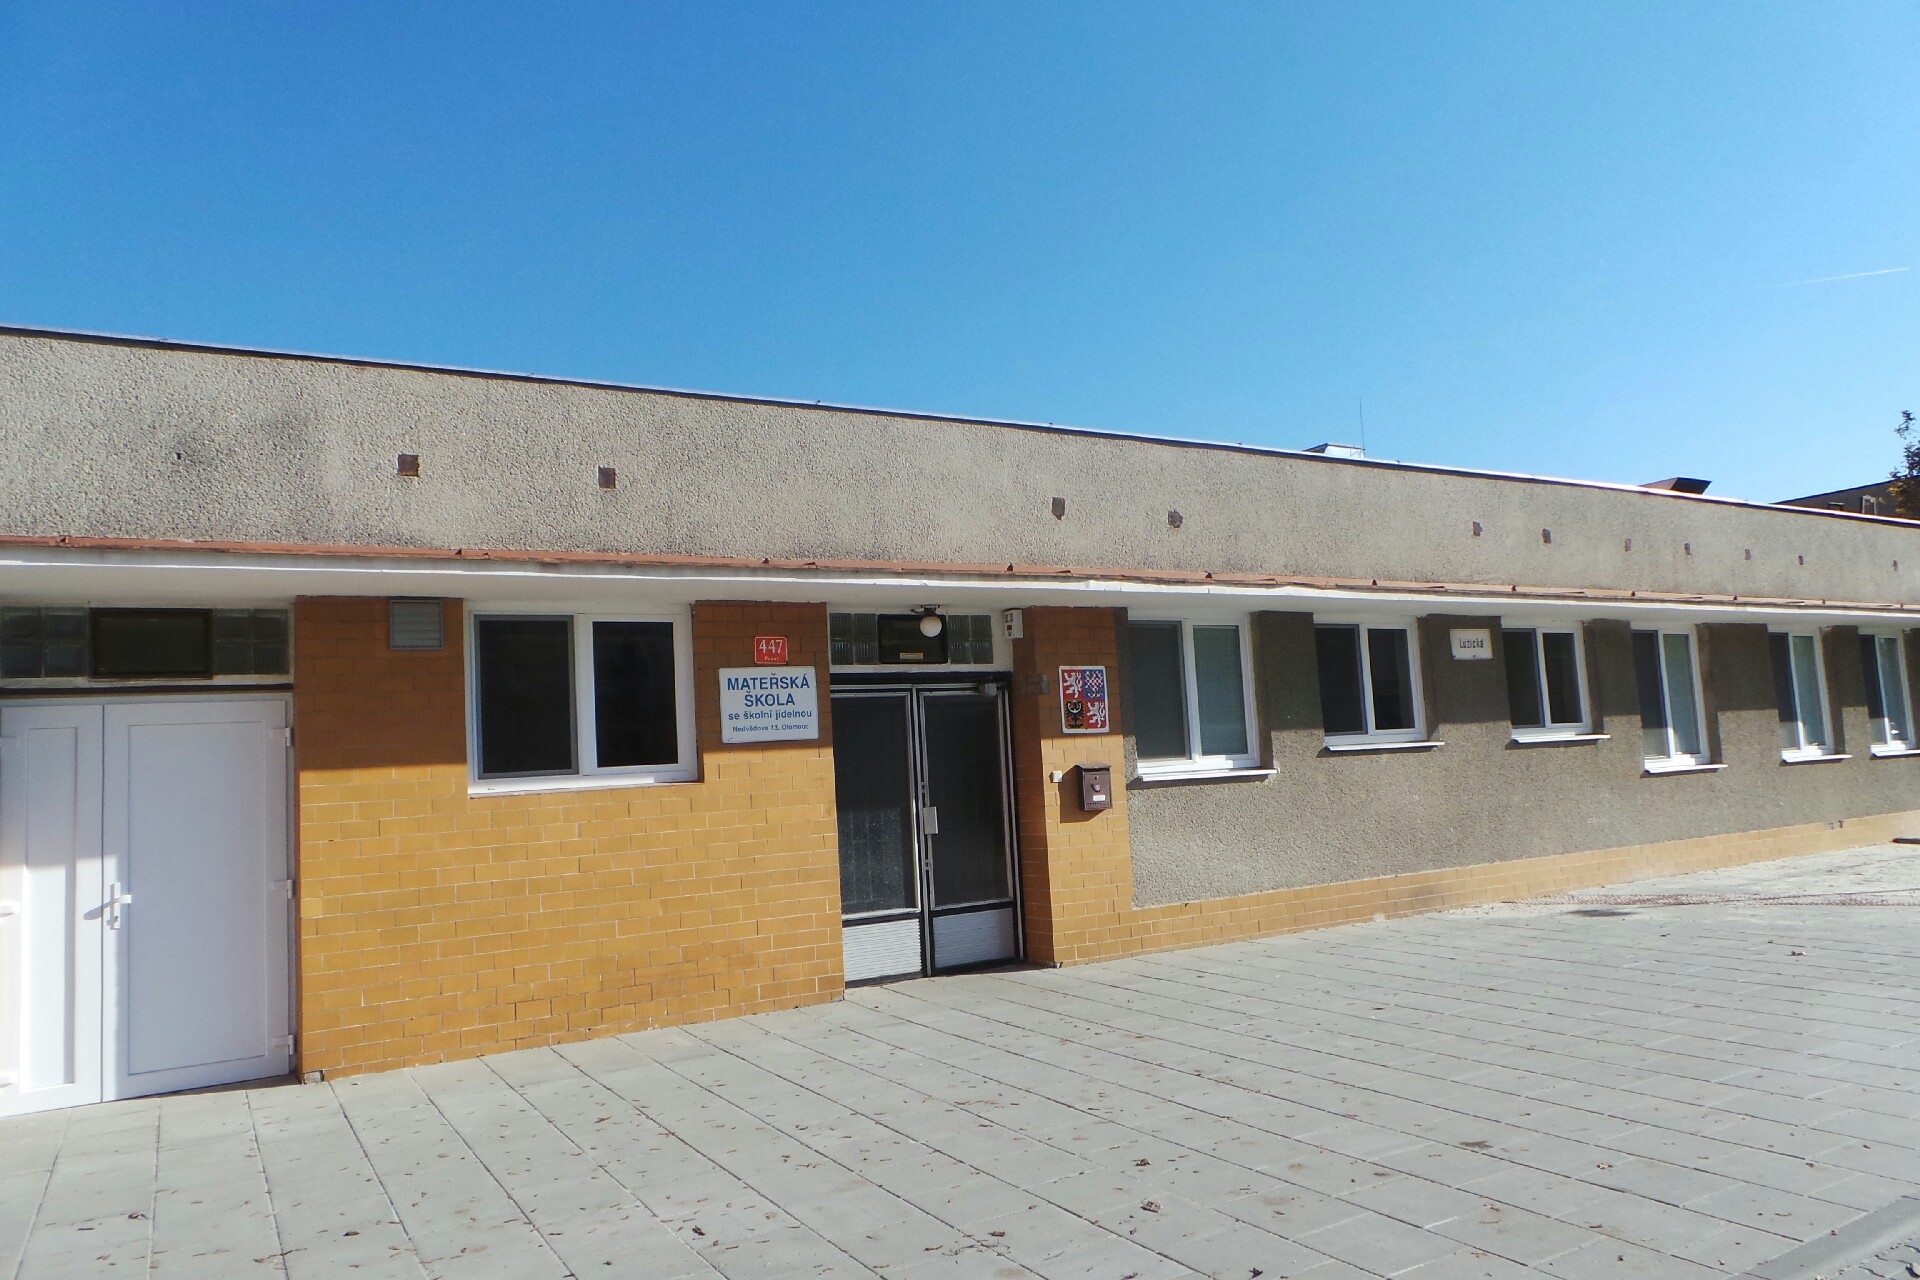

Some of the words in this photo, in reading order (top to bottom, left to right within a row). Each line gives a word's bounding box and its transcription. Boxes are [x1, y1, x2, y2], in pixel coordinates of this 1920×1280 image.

[758, 639, 783, 654] 447
[727, 672, 810, 691] MATEŘSKÁ
[744, 690, 796, 707] ŠKOLA
[743, 709, 773, 720] školní
[775, 709, 812, 721] jídelnou
[781, 723, 809, 731] Olomouc
